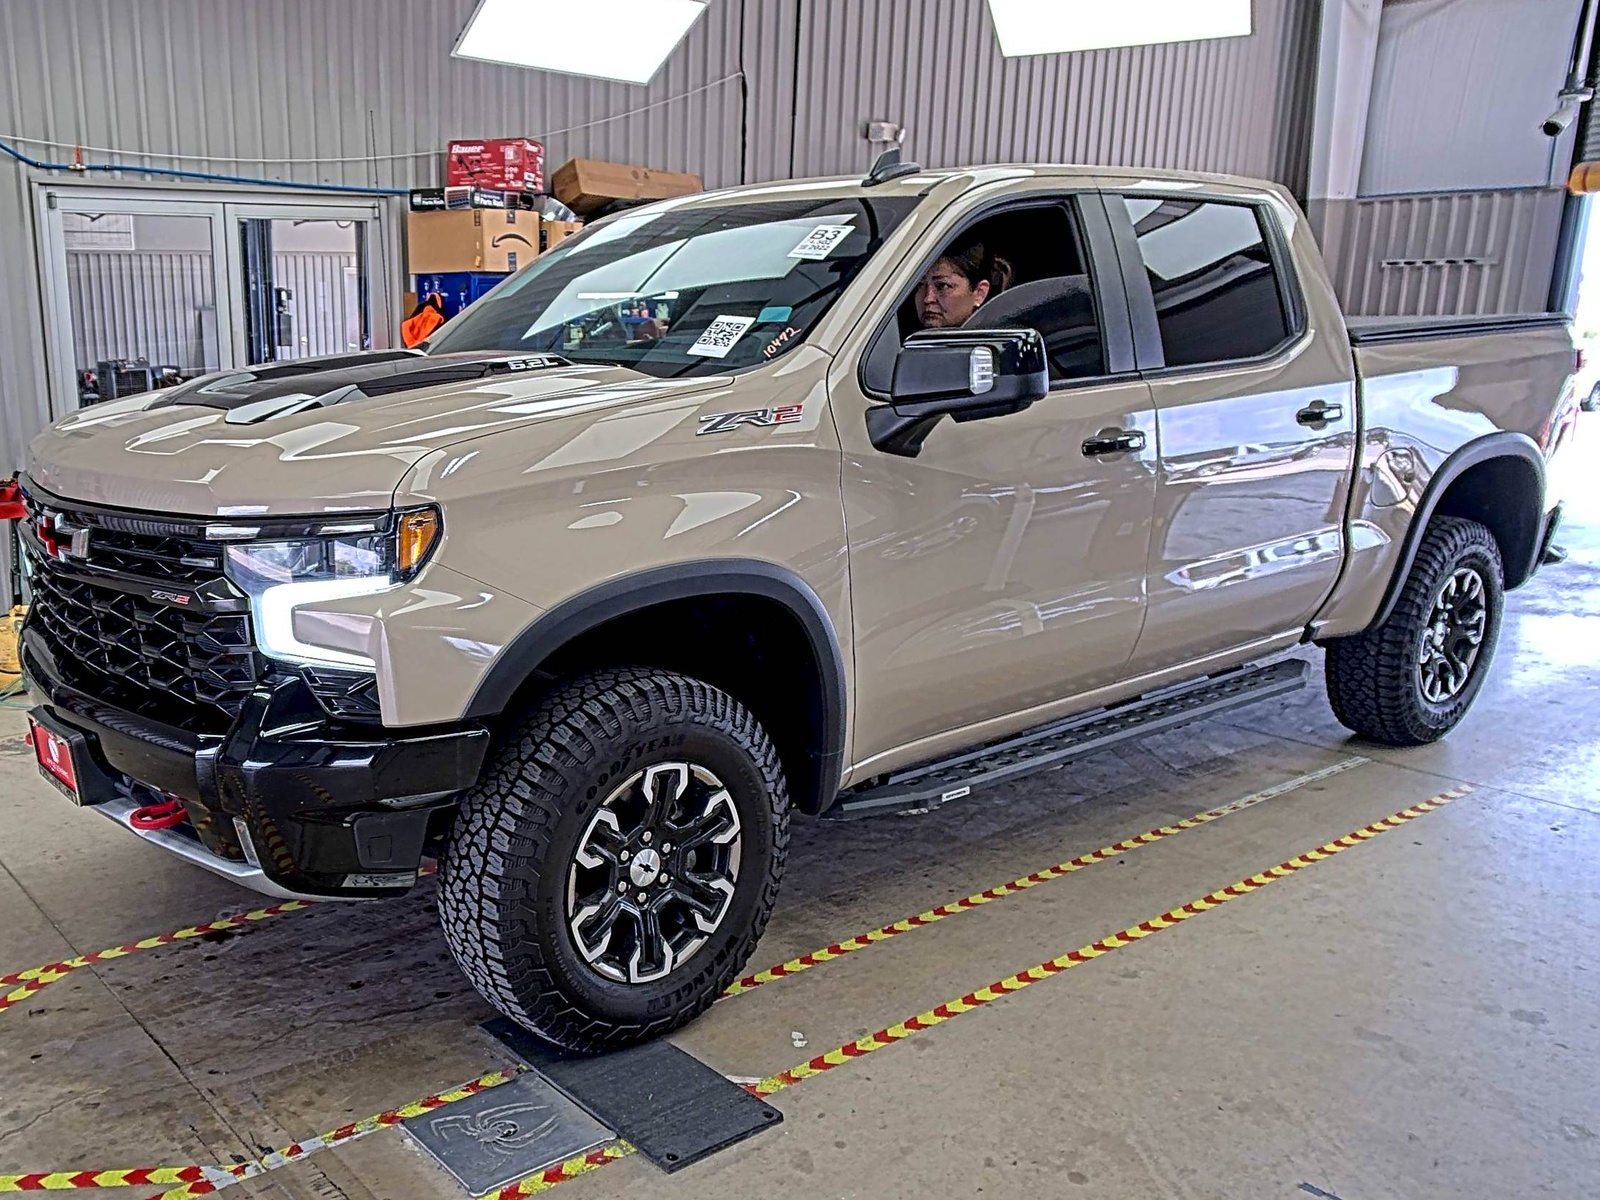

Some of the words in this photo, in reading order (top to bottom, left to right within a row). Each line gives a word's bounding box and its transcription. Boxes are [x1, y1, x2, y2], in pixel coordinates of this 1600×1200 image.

[451, 144, 485, 154] Bauer
[809, 229, 842, 241] B3
[762, 326, 802, 358] 10472
[695, 404, 803, 436] ZR2
[151, 589, 190, 605] ZR2
